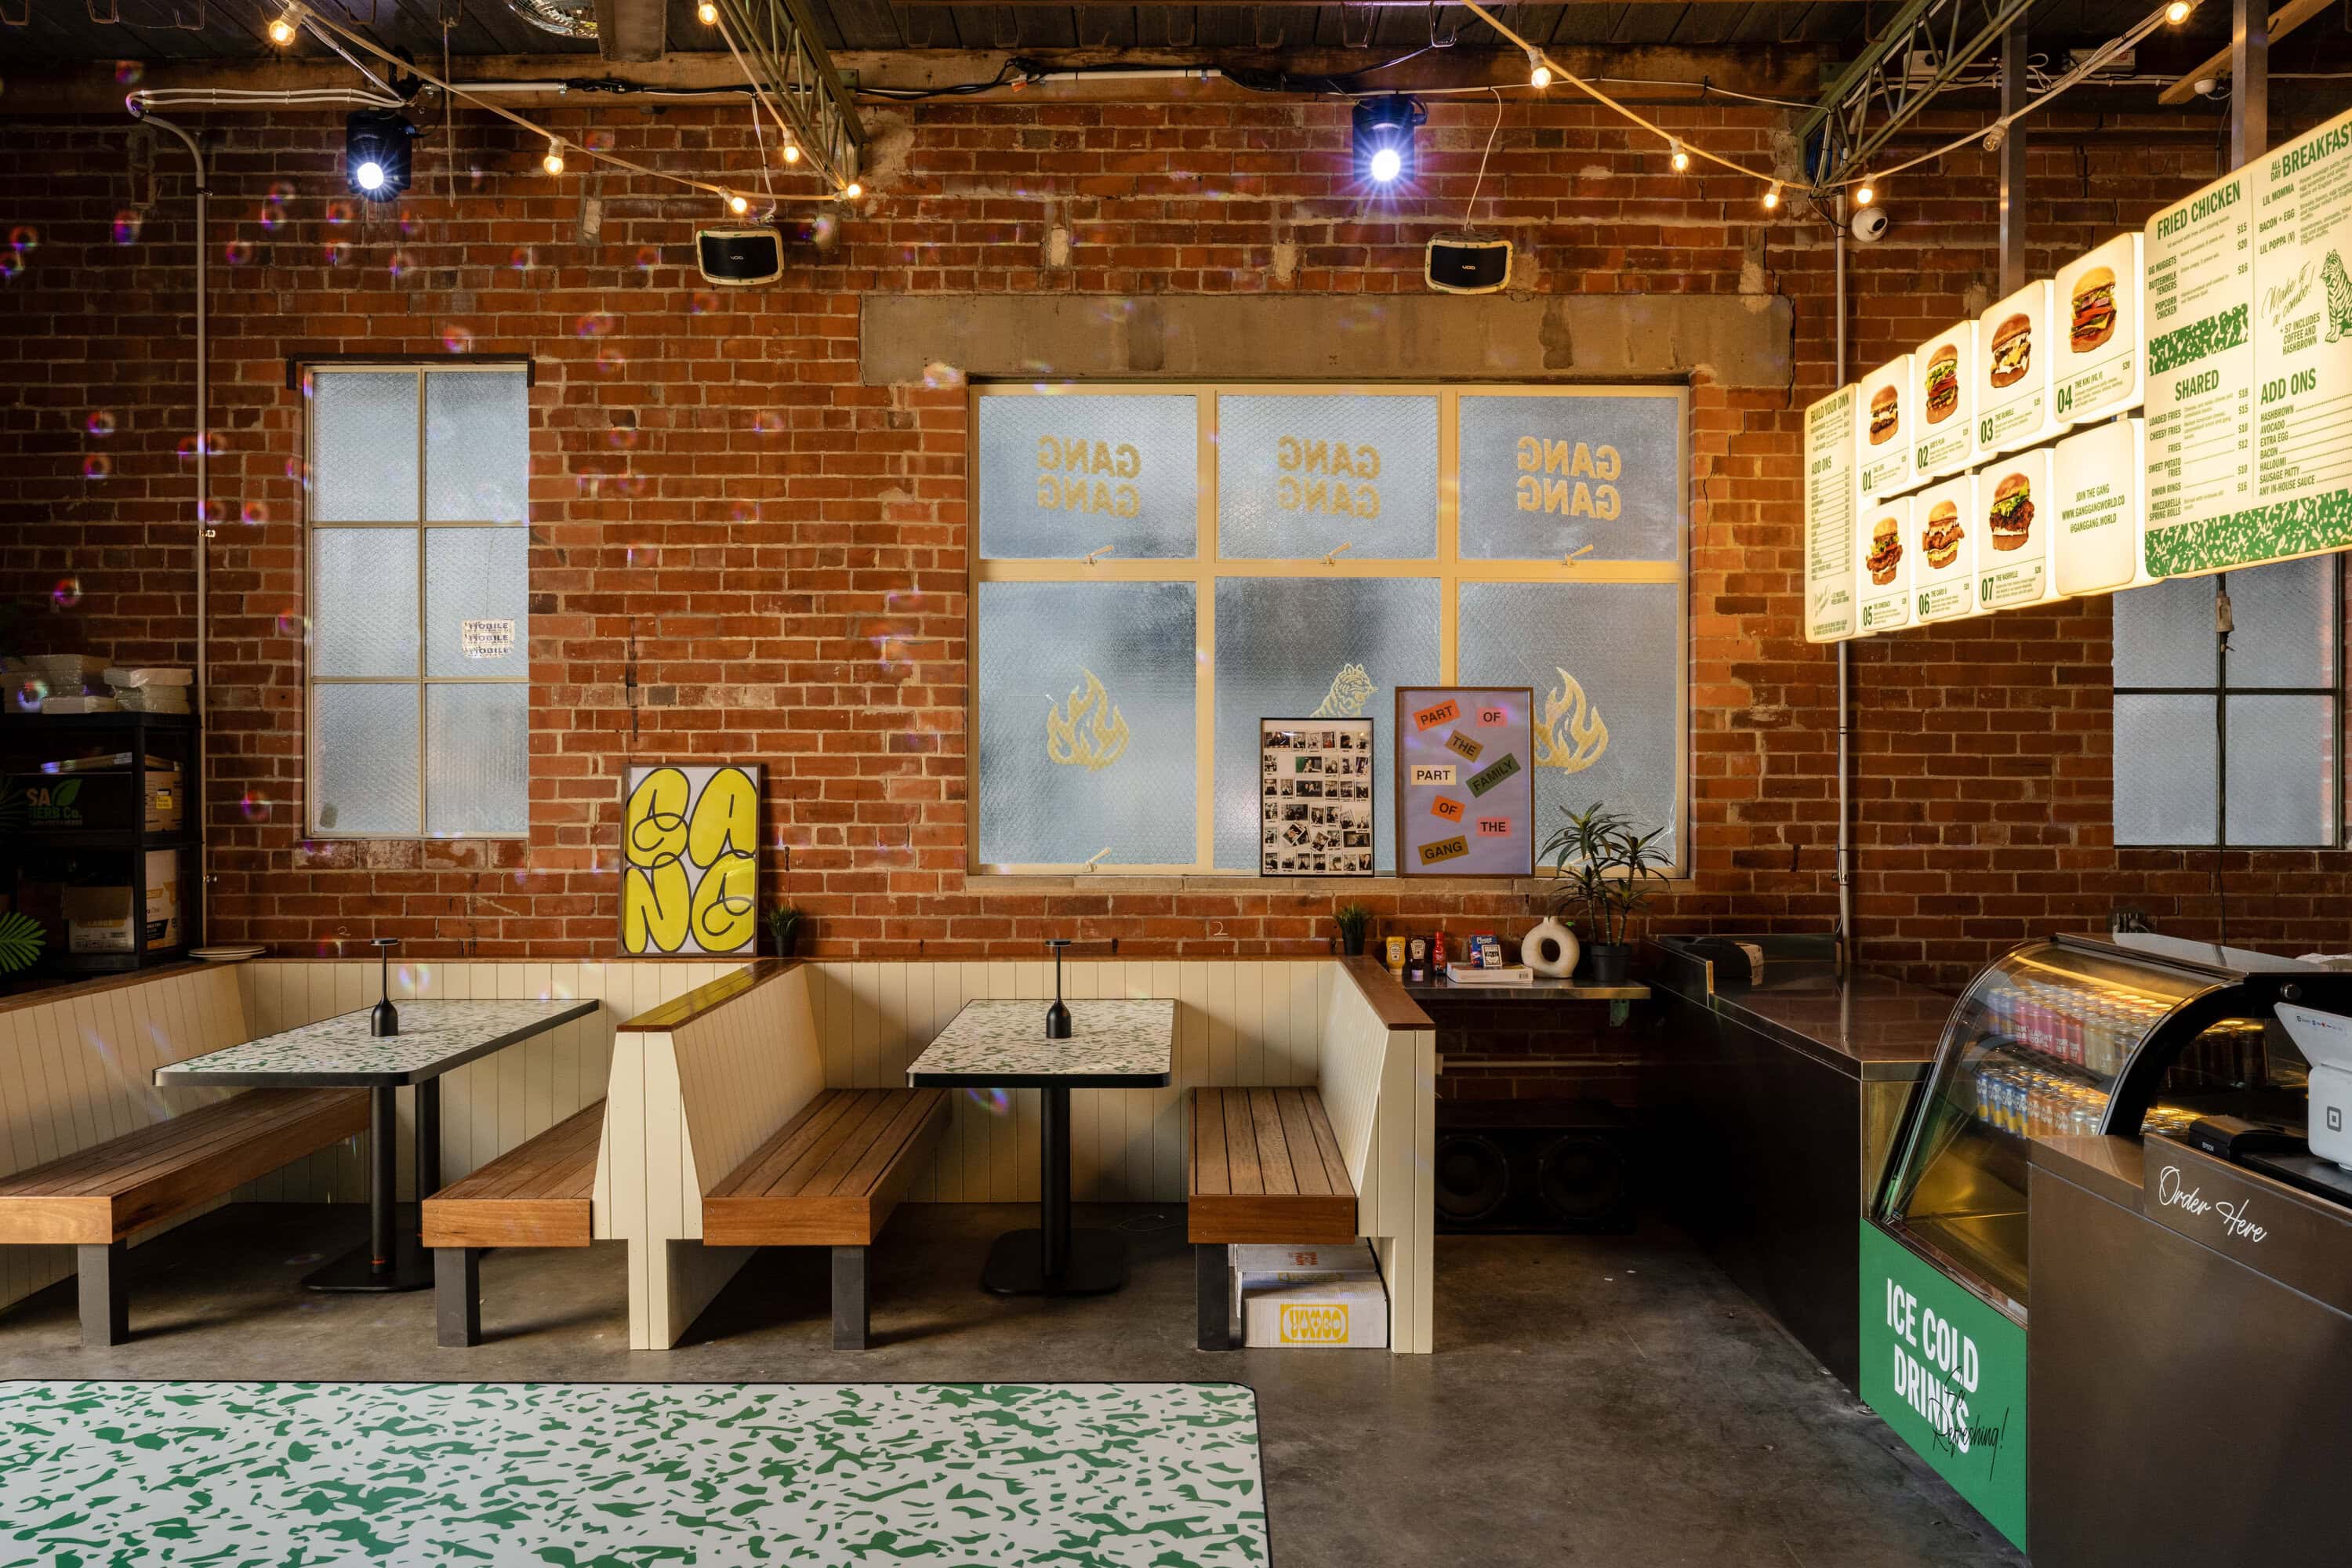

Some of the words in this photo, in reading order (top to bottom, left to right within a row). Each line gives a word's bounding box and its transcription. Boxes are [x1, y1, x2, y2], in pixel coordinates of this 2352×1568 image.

[2271, 158, 2281, 172] ALL
[2270, 169, 2281, 182] DAY
[2272, 183, 2294, 201] MOMMA
[2158, 209, 2187, 240] FRIED
[2191, 180, 2240, 223] CHICKEN
[2237, 222, 2247, 234] $15
[2259, 216, 2277, 232] BACON
[2284, 208, 2295, 221] EGG
[2269, 235, 2286, 251] POPPA
[2156, 256, 2176, 272] NUGGETS
[2148, 271, 2176, 290] BUTTERMILK
[2157, 281, 2176, 296] TENDERS
[2155, 296, 2176, 312] POPCORN
[2157, 305, 2176, 320] CHICKEN
[2293, 312, 2320, 329] INCLUDES
[2284, 331, 2303, 344] COFFEE
[2305, 325, 2316, 337] AND
[2283, 335, 2317, 355] HASHBROWN
[2175, 369, 2219, 401] SHARED
[2260, 378, 2286, 405] ADD
[2291, 368, 2316, 395] ONS
[1811, 406, 1824, 423] BUILD
[1824, 398, 1837, 416] YOUR
[1838, 393, 1849, 409] OWN
[2057, 384, 2072, 414] 04
[2149, 413, 2167, 426] LOADED
[2168, 409, 2181, 420] FRIES
[2260, 405, 2294, 423] HASHBROWN
[1980, 417, 1993, 444] 03
[2150, 429, 2167, 441] CHEESY
[2168, 425, 2181, 435] FRIES
[2260, 419, 2285, 435] AVOCADO
[2168, 442, 2181, 453] FRIES
[2260, 435, 2276, 447] EXTRA
[2278, 431, 2288, 442] EGG
[1918, 445, 1928, 469] 02
[2260, 447, 2278, 459] BACON
[1812, 460, 1821, 476] ADD
[1822, 456, 1831, 470] ONS
[2148, 462, 2163, 474] SWEET
[2164, 458, 2181, 469] POTATO
[2168, 467, 2181, 477] FRIES
[2259, 457, 2286, 472] HALLOUMI
[1863, 470, 1872, 492] 01
[2259, 470, 2283, 484] SAUSAGE
[2285, 466, 2299, 477] PATTY
[2076, 491, 2085, 502] JOIN
[2096, 484, 2109, 495] GANG
[2151, 485, 2165, 497] ONION
[2167, 482, 2181, 493] RINGS
[2259, 486, 2269, 496] ANY
[2270, 479, 2296, 493] IN-HOUSE
[2297, 475, 2315, 487] SAUCE
[2149, 510, 2165, 521] SPRING
[2167, 506, 2180, 517] ROLLS
[2152, 498, 2181, 511] MOZZARELLA
[1982, 577, 1994, 601] 07
[1919, 593, 1929, 615] 06
[1864, 605, 1872, 626] 05
[1420, 706, 1453, 725] PART
[1483, 712, 1501, 723] OF
[1452, 735, 1476, 757] THE
[1417, 770, 1450, 781] PART
[1472, 761, 1513, 792] FAMILY
[26, 788, 51, 806] SA
[1439, 802, 1457, 816] OF
[1480, 821, 1506, 833] THE
[1424, 841, 1462, 860] GANG
[2159, 1165, 2212, 1215] Order
[2216, 1199, 2267, 1243] Here
[1887, 1277, 1917, 1347] ICE
[1922, 1308, 1979, 1393] COLD
[1894, 1343, 1970, 1453] DRINKS
[1929, 1397, 2009, 1482] Refreshing!
